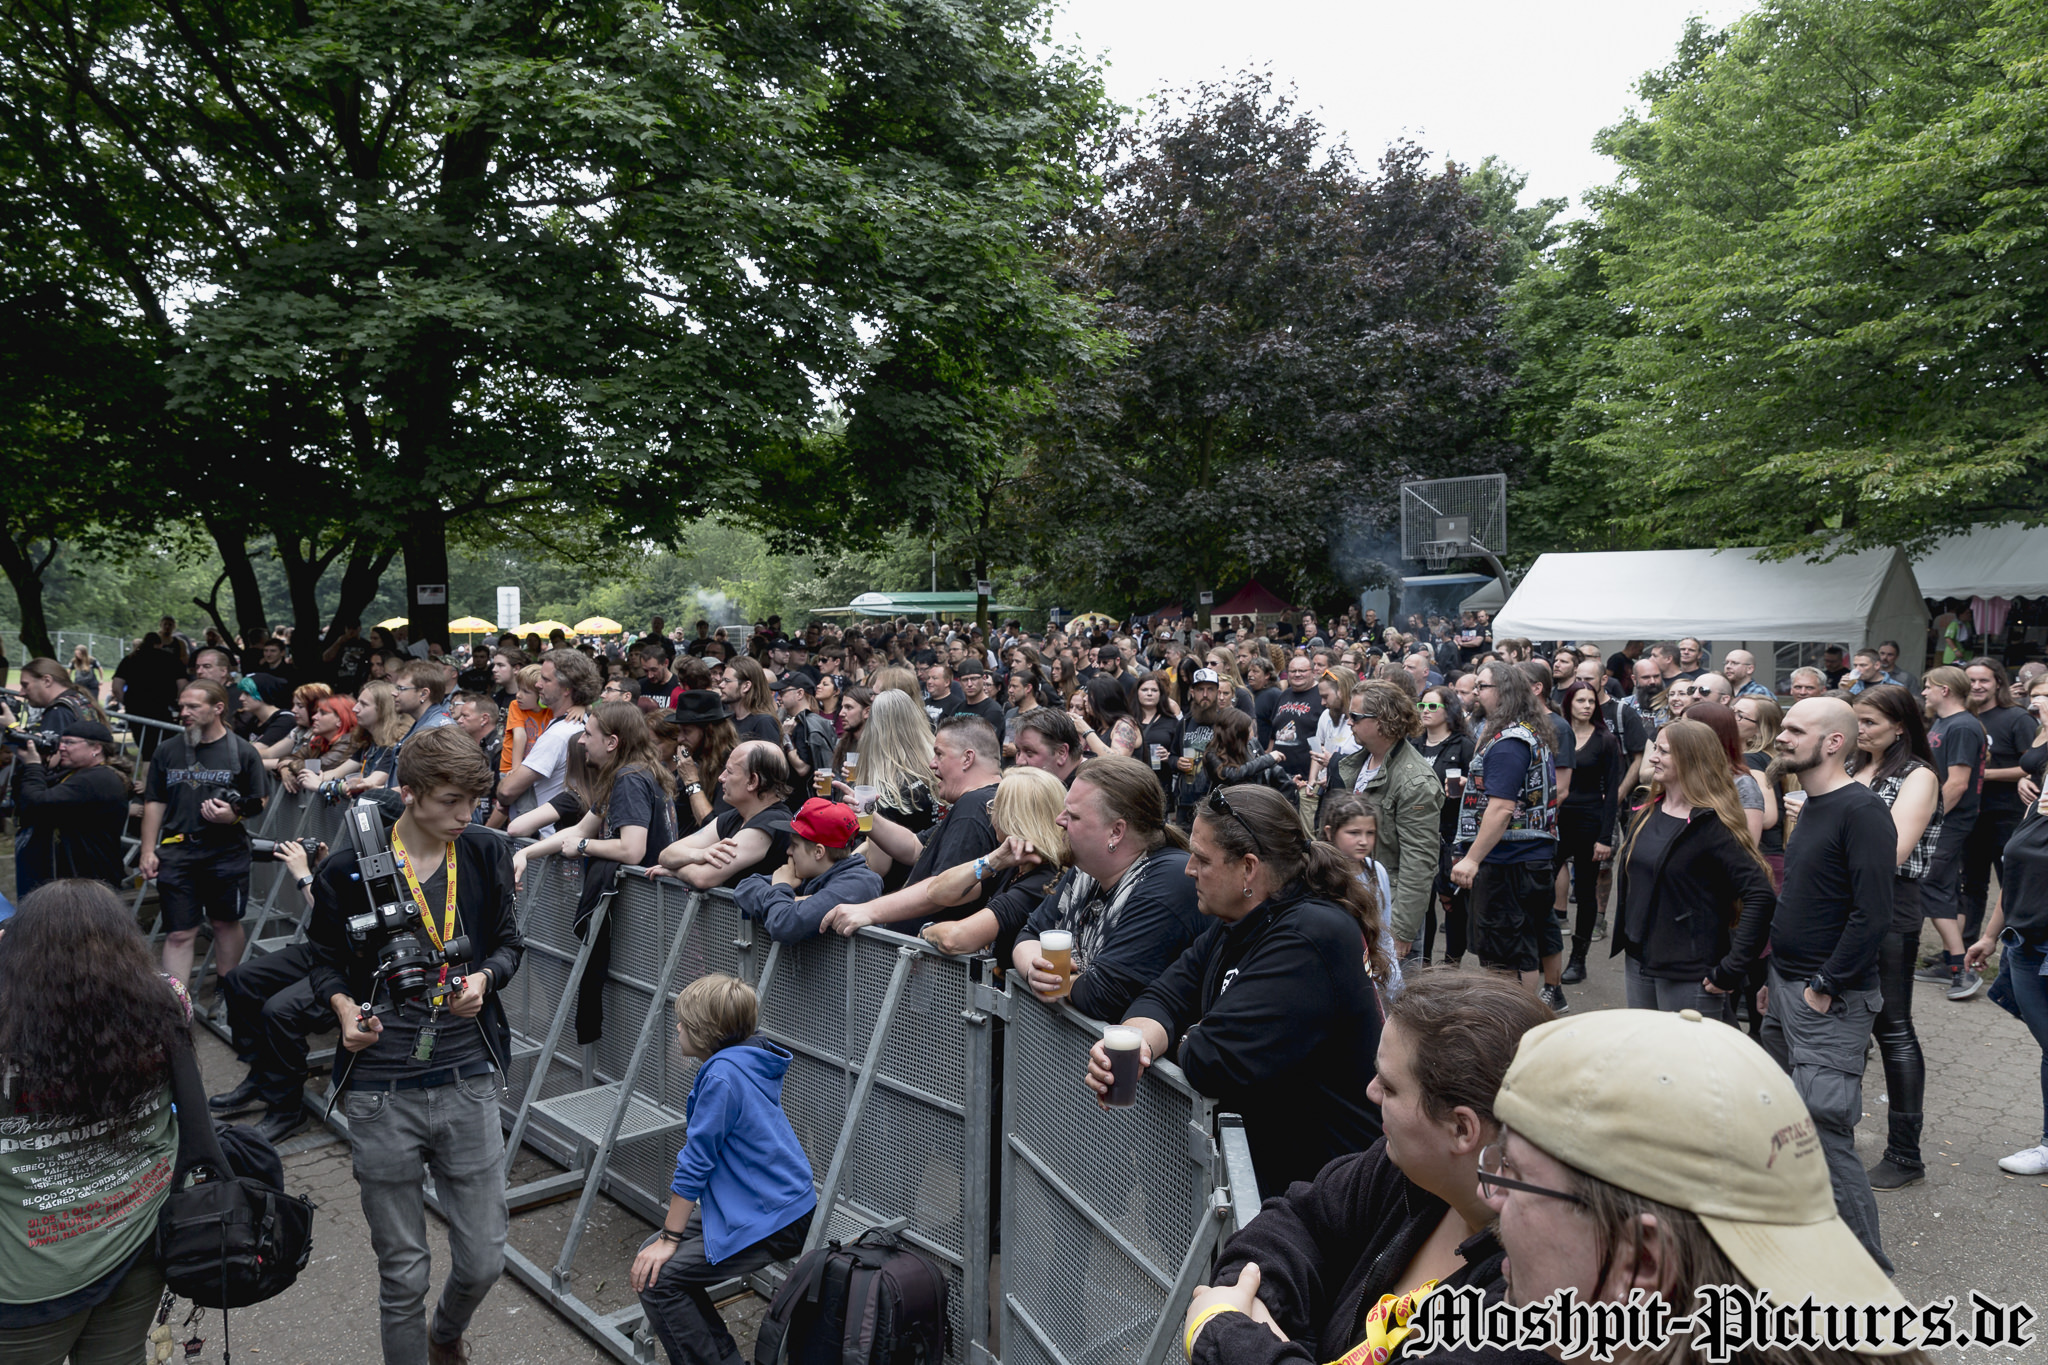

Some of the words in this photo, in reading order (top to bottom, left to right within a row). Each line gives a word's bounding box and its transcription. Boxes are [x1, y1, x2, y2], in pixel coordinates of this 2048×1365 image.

[417, 893, 429, 917] Sinalco
[12, 1162, 45, 1175] STEREO
[141, 1125, 155, 1138] GOD
[22, 1192, 57, 1207] BLOOD
[82, 1174, 116, 1191] WORDS
[39, 1195, 75, 1210] SACRED
[27, 1212, 92, 1239] DUISBURG
